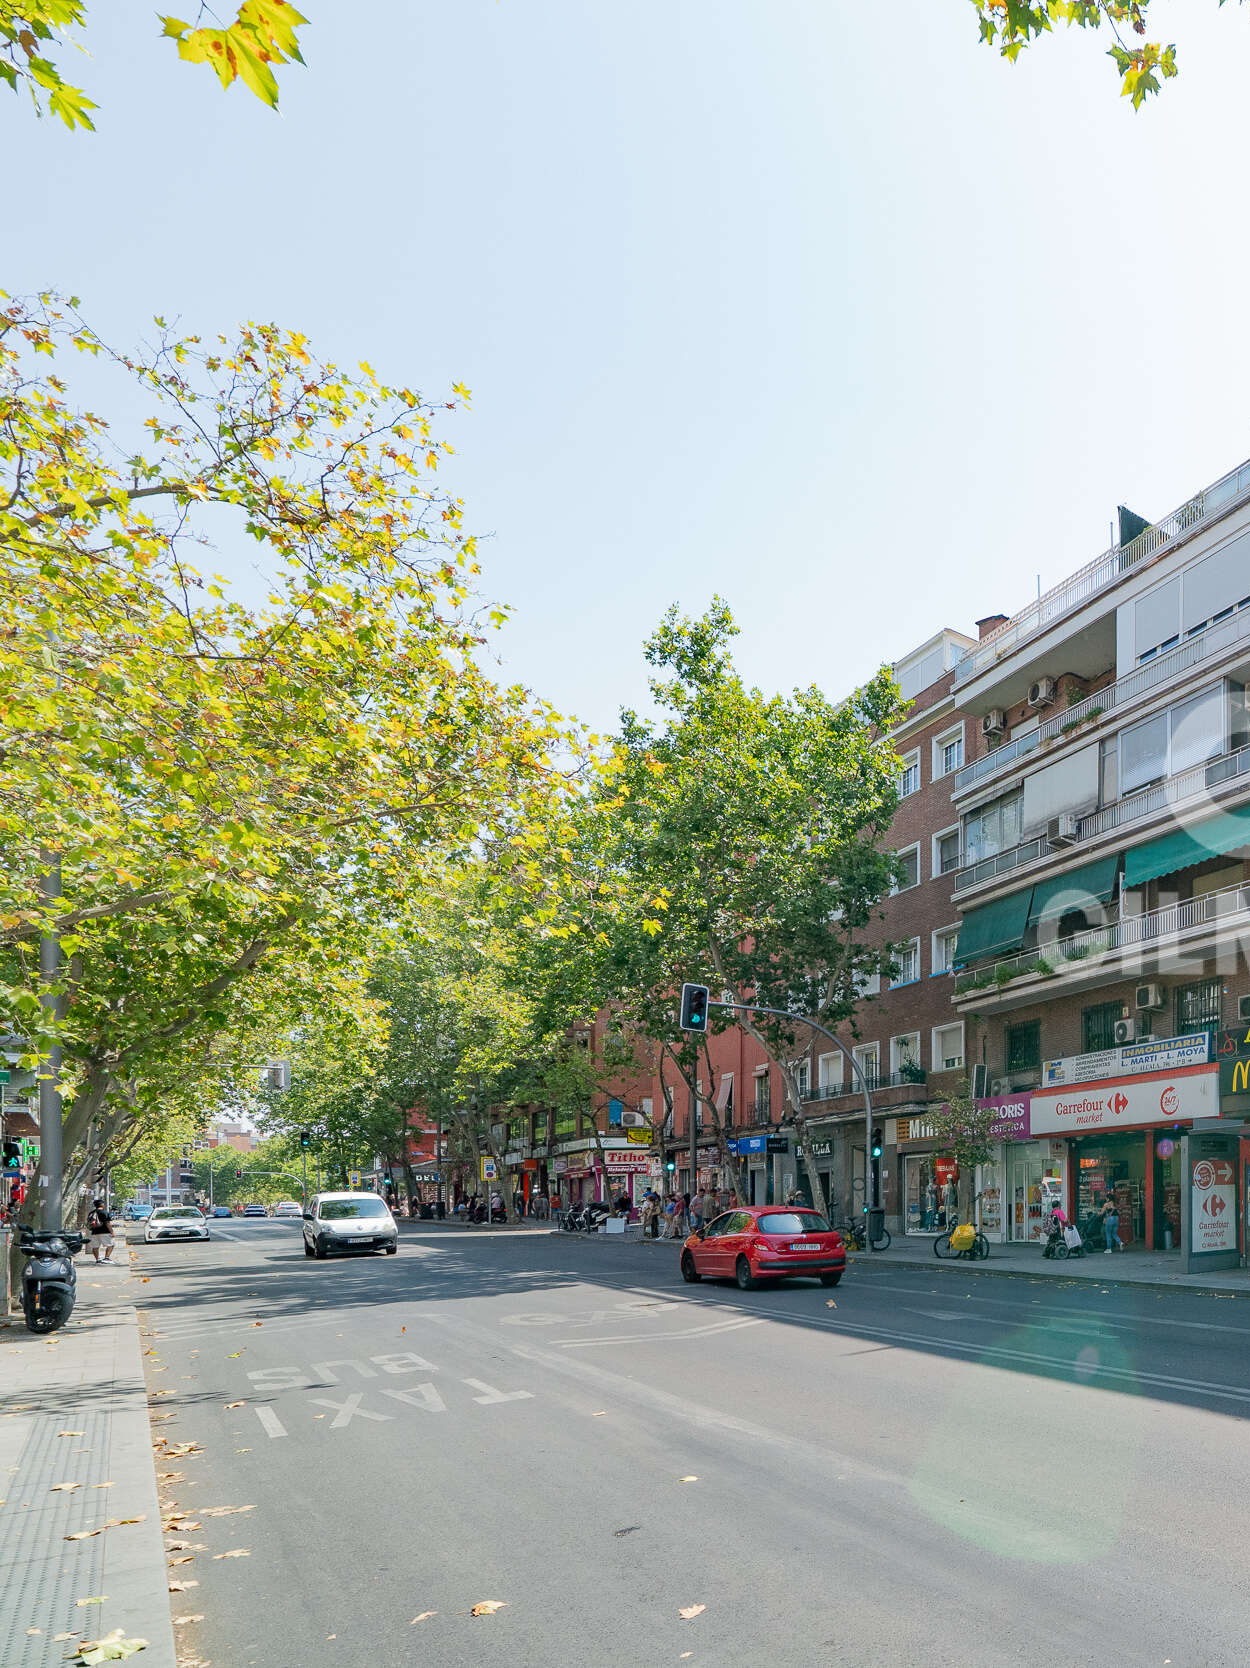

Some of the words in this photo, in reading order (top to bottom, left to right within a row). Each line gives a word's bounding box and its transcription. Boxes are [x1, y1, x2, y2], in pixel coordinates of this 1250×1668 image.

[1122, 1037, 1204, 1057] INMOBILIARIA
[1130, 1055, 1157, 1065] MARTI
[1177, 1047, 1205, 1058] MOYA
[1055, 1099, 1104, 1116] Carrefour
[1075, 1112, 1104, 1125] market
[246, 1351, 439, 1391] BUS
[254, 1377, 536, 1439] TAXI
